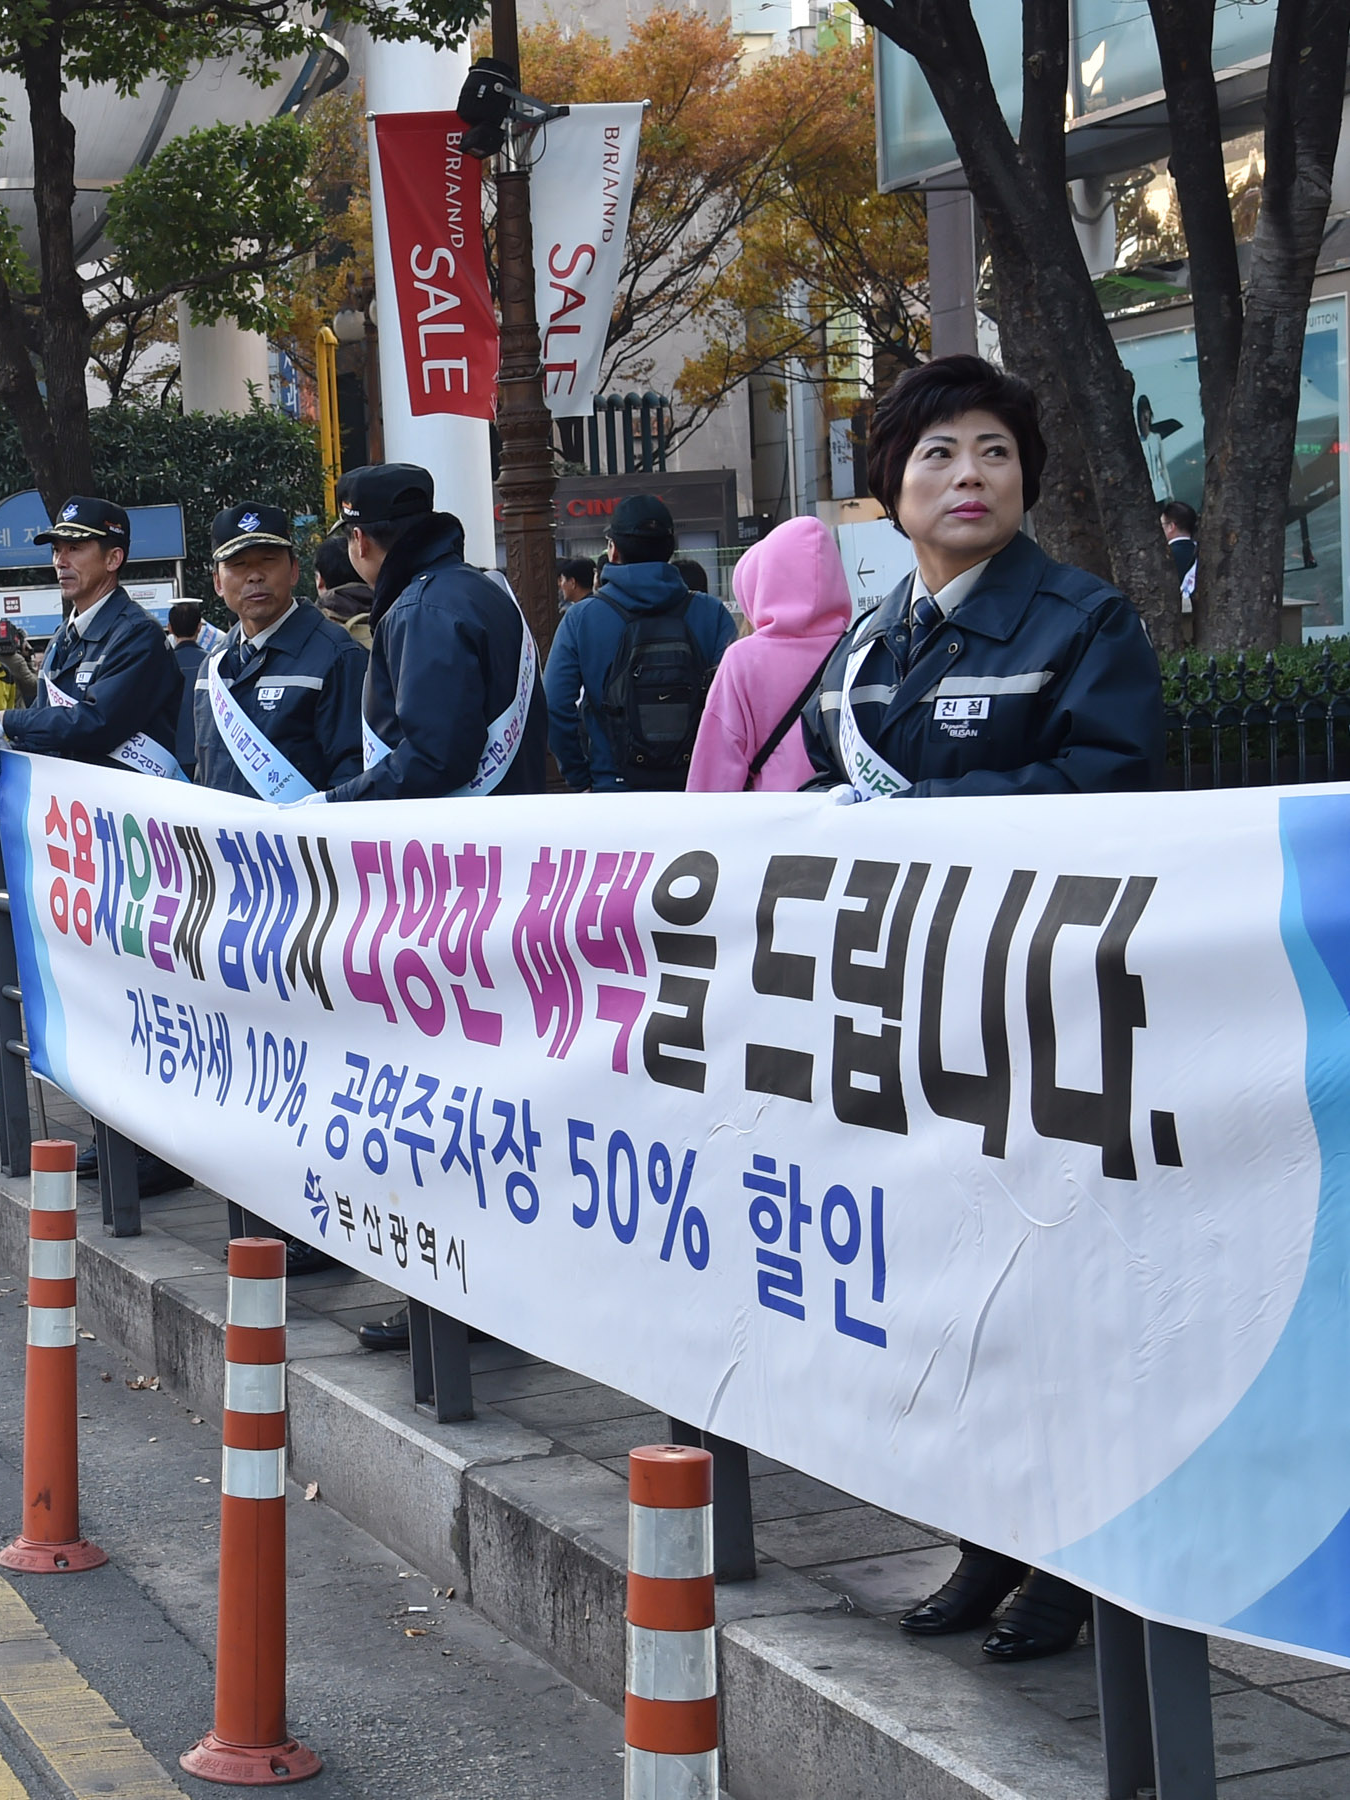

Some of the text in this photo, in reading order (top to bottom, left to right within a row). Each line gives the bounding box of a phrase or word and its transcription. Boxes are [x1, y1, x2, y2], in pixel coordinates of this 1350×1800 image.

[445, 131, 465, 249] B/R/A/N/D
[601, 126, 621, 243] B/R/A/N/D
[410, 244, 468, 394] SALE
[543, 243, 595, 397] SALE
[1306, 312, 1339, 328] UITTON
[121, 745, 167, 778] 양심선
[941, 700, 983, 717] 친절
[949, 729, 979, 738] BUSAN
[45, 795, 1183, 1182] 승용차요일제 참여시 다양한 혜택을 드립니다.
[126, 988, 888, 1350] 자동차세 10%, 공영주차장 50% 할인
[335, 1190, 469, 1295] 부산광역시
